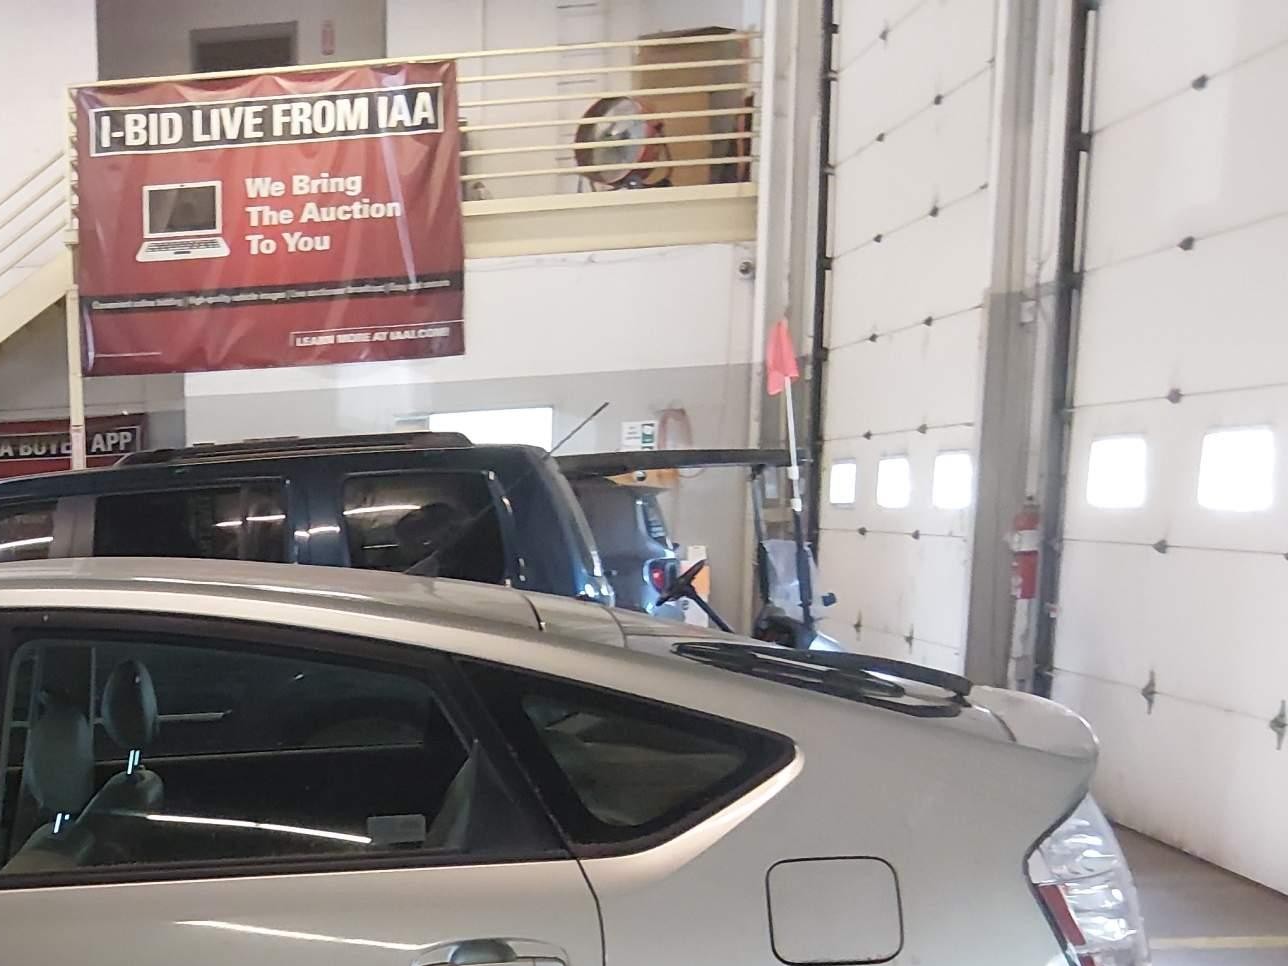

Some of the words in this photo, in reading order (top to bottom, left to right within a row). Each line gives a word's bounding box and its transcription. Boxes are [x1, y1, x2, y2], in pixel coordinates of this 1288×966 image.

[100, 112, 184, 148] I-BID
[192, 105, 269, 143] LIVE
[272, 97, 369, 137] FROM
[376, 91, 435, 129] IAA
[245, 176, 286, 199] We
[292, 172, 362, 197] Bring
[245, 205, 295, 227] The
[299, 198, 402, 224] Auction
[245, 234, 278, 255] To
[282, 231, 331, 253] You
[18, 438, 73, 457] BUYE
[91, 431, 133, 453] APP
